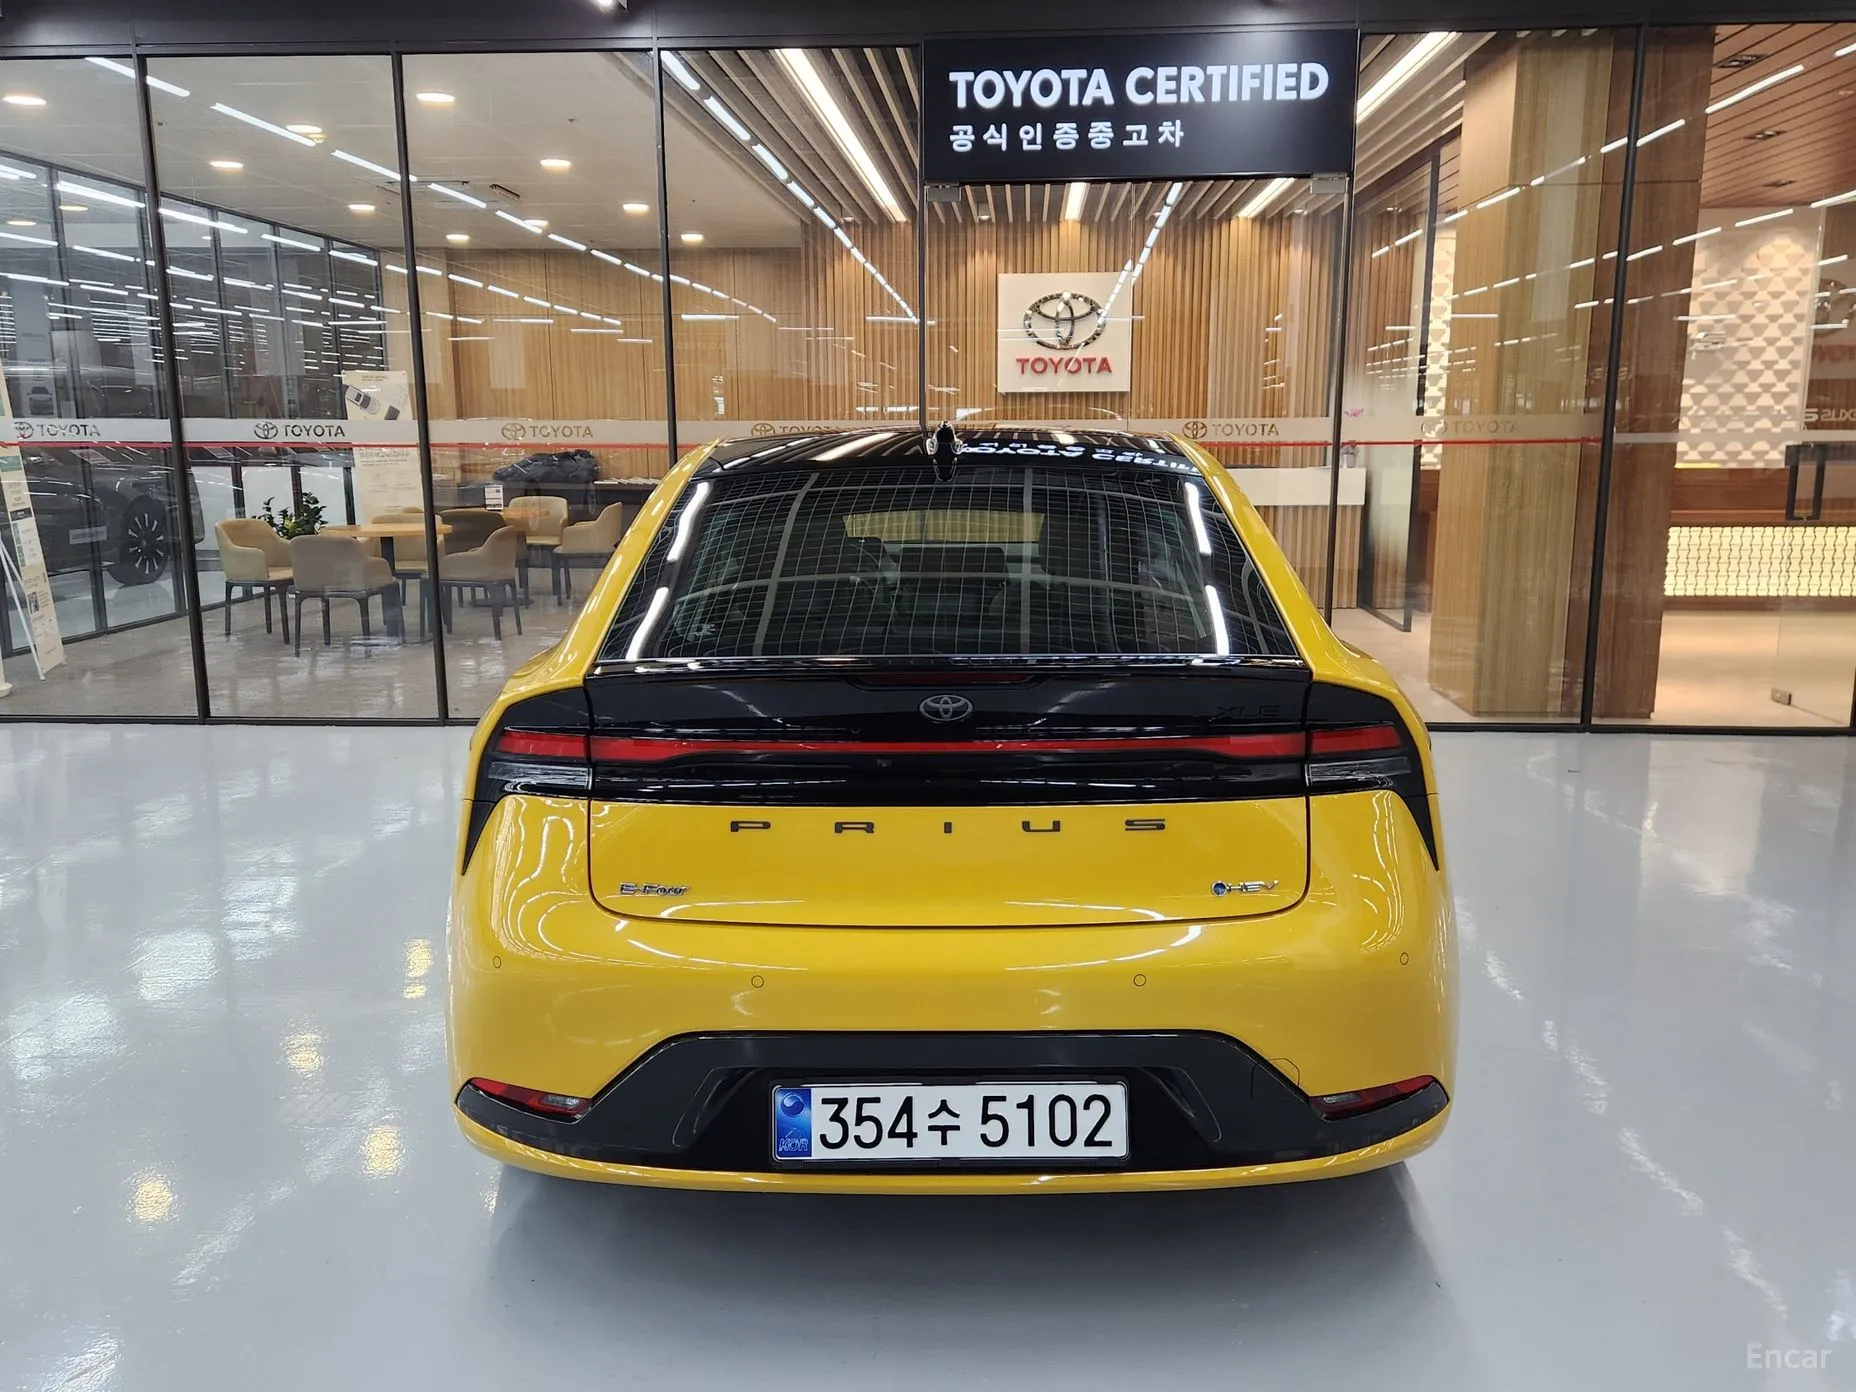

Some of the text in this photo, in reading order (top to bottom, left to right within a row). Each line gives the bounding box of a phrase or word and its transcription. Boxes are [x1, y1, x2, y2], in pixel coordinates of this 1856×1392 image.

[948, 62, 1329, 109] TOYOTA CERTIFIED
[1015, 356, 1112, 375] TOYOTA
[37, 423, 101, 436] TOYOTA
[284, 424, 346, 437] TOYOTA
[529, 425, 594, 438] TOYOTA
[1211, 423, 1280, 437] TOYOTA
[1452, 419, 1521, 434] TOYOTA
[1213, 703, 1284, 719] XLE
[730, 818, 1166, 834] PRIUS
[1226, 880, 1279, 893] HEV
[819, 1093, 1114, 1150] 354수 5102
[778, 1137, 809, 1152] KOR
